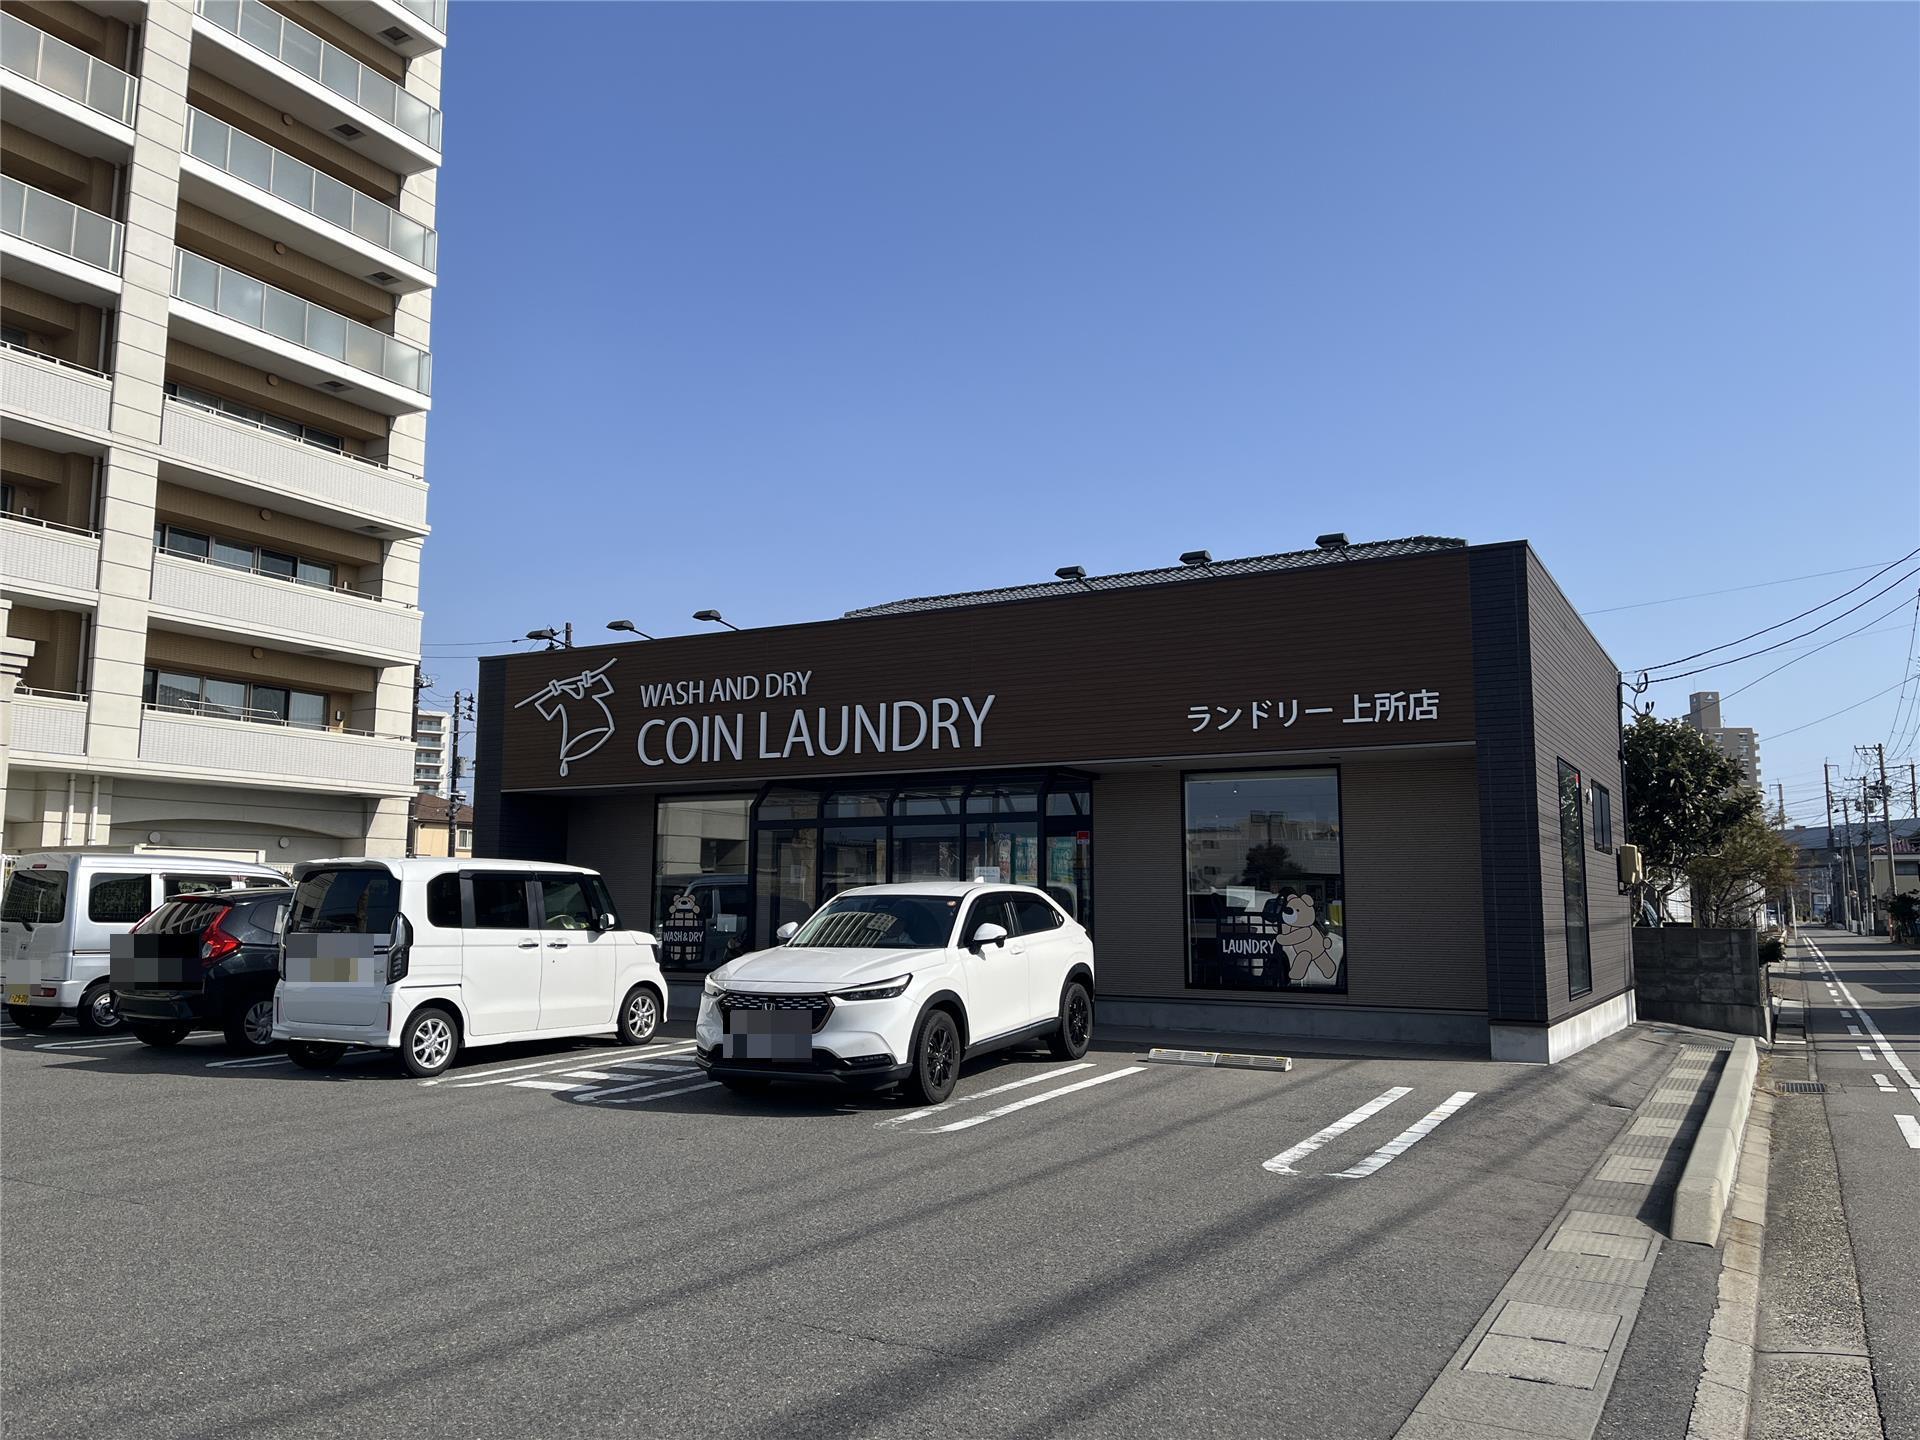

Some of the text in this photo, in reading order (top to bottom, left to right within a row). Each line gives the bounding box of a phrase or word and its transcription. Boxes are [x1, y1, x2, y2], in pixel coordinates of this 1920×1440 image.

[640, 670, 812, 708] WASH AND DRY
[637, 694, 996, 766] COIN LAUNDRY
[1222, 938, 1276, 955] LAUNDRY
